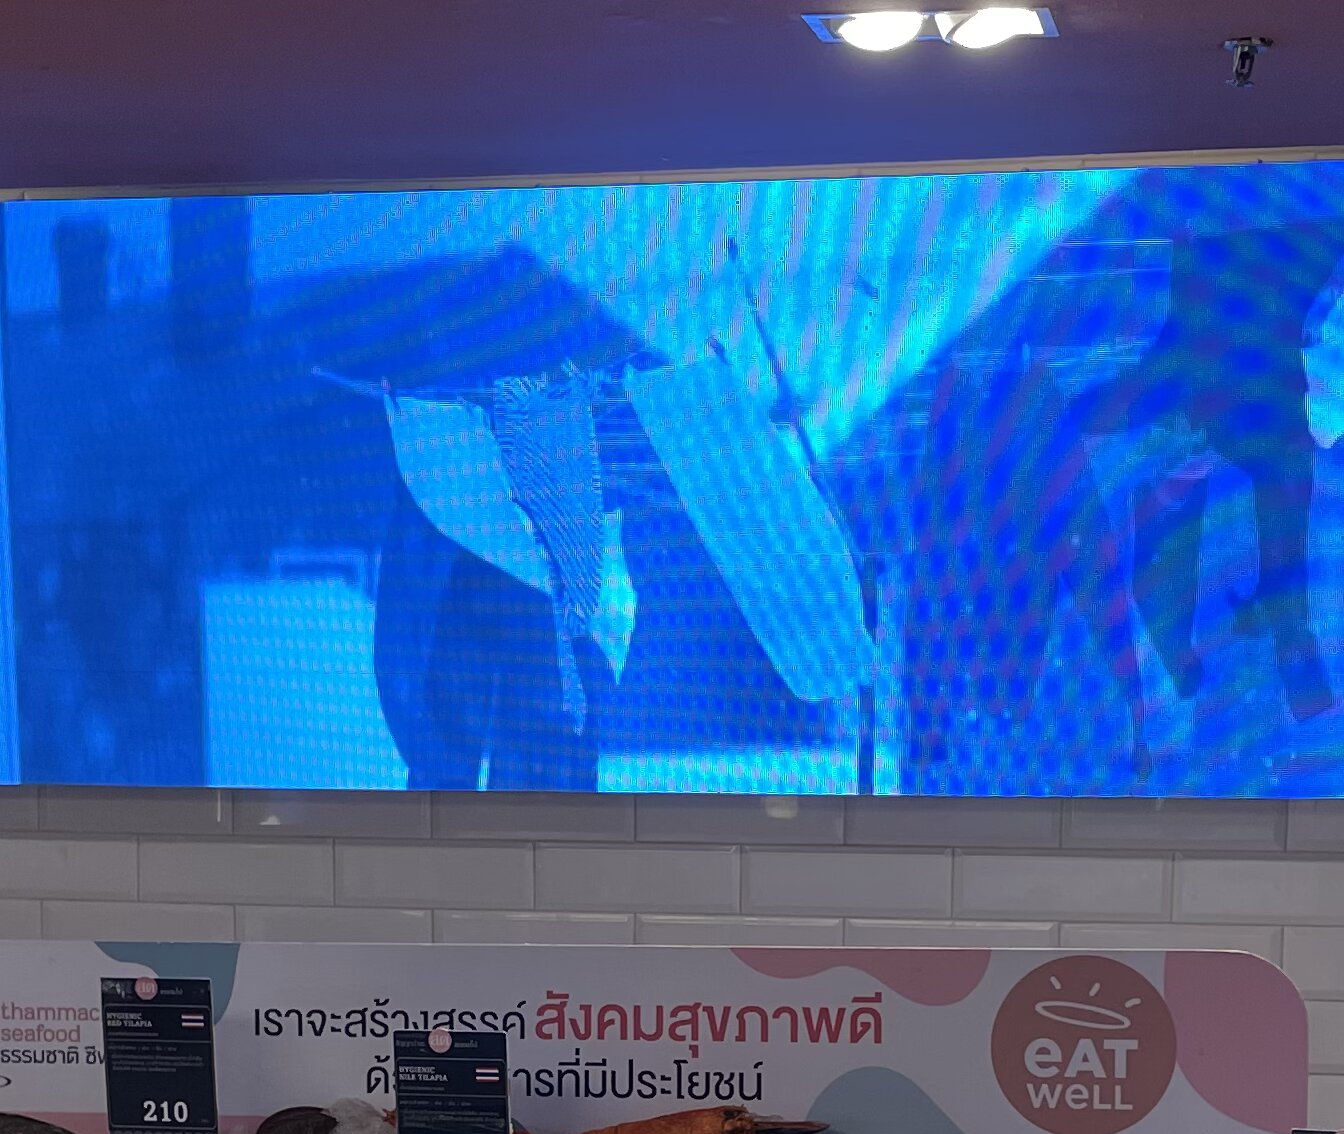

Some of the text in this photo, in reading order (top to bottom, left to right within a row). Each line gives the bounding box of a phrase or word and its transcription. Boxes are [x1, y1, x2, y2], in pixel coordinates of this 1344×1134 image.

[0, 1002, 100, 1022] thammac
[0, 1024, 81, 1043] seafood
[534, 990, 883, 1058] สังคมสุขภาพดี
[0, 1046, 79, 1065] ธรรมชาติ
[143, 1100, 189, 1123] 210
